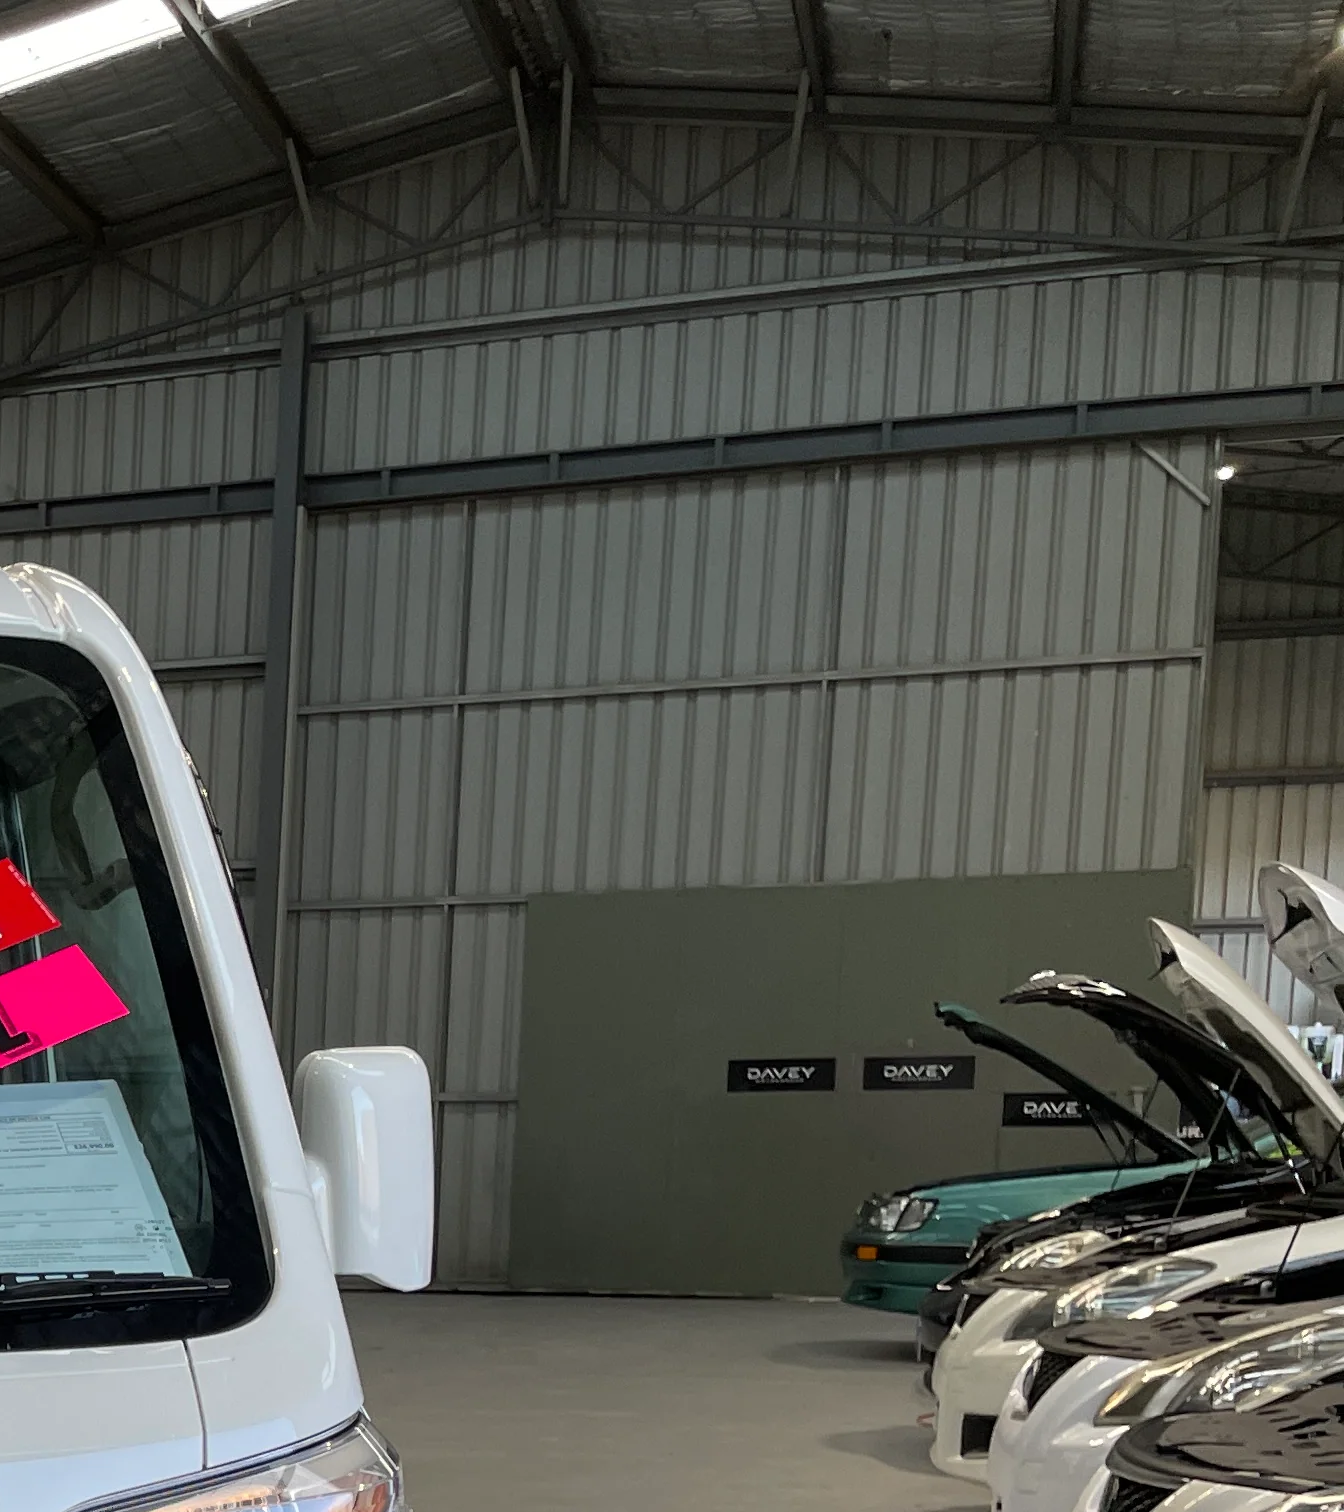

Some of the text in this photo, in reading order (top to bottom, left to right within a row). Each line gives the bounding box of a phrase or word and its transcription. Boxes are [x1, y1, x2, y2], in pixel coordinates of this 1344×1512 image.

[747, 1066, 815, 1080] DAVEY
[883, 1064, 953, 1078] DAVEY
[1023, 1101, 1082, 1115] DAVE
